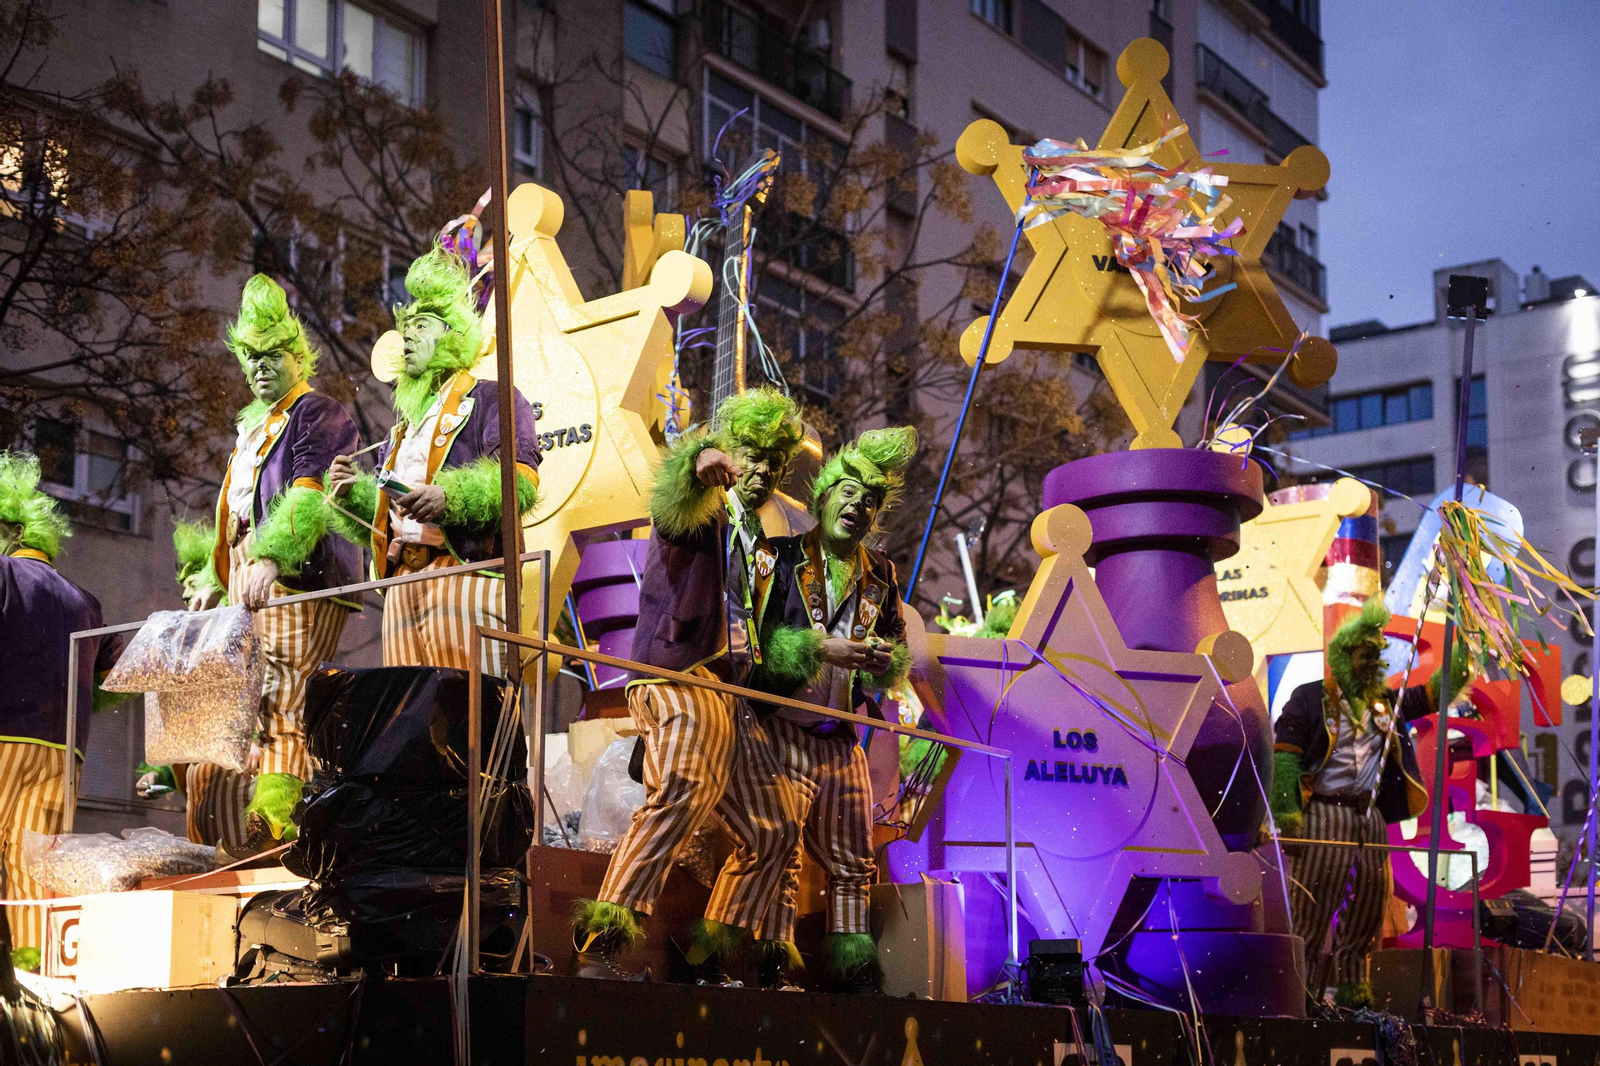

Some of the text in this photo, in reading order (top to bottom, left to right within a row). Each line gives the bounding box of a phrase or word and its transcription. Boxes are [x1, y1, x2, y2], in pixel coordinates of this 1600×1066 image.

[1217, 568, 1242, 582] AS
[1053, 727, 1097, 751] LOS
[1024, 759, 1129, 786] ALELUYA
